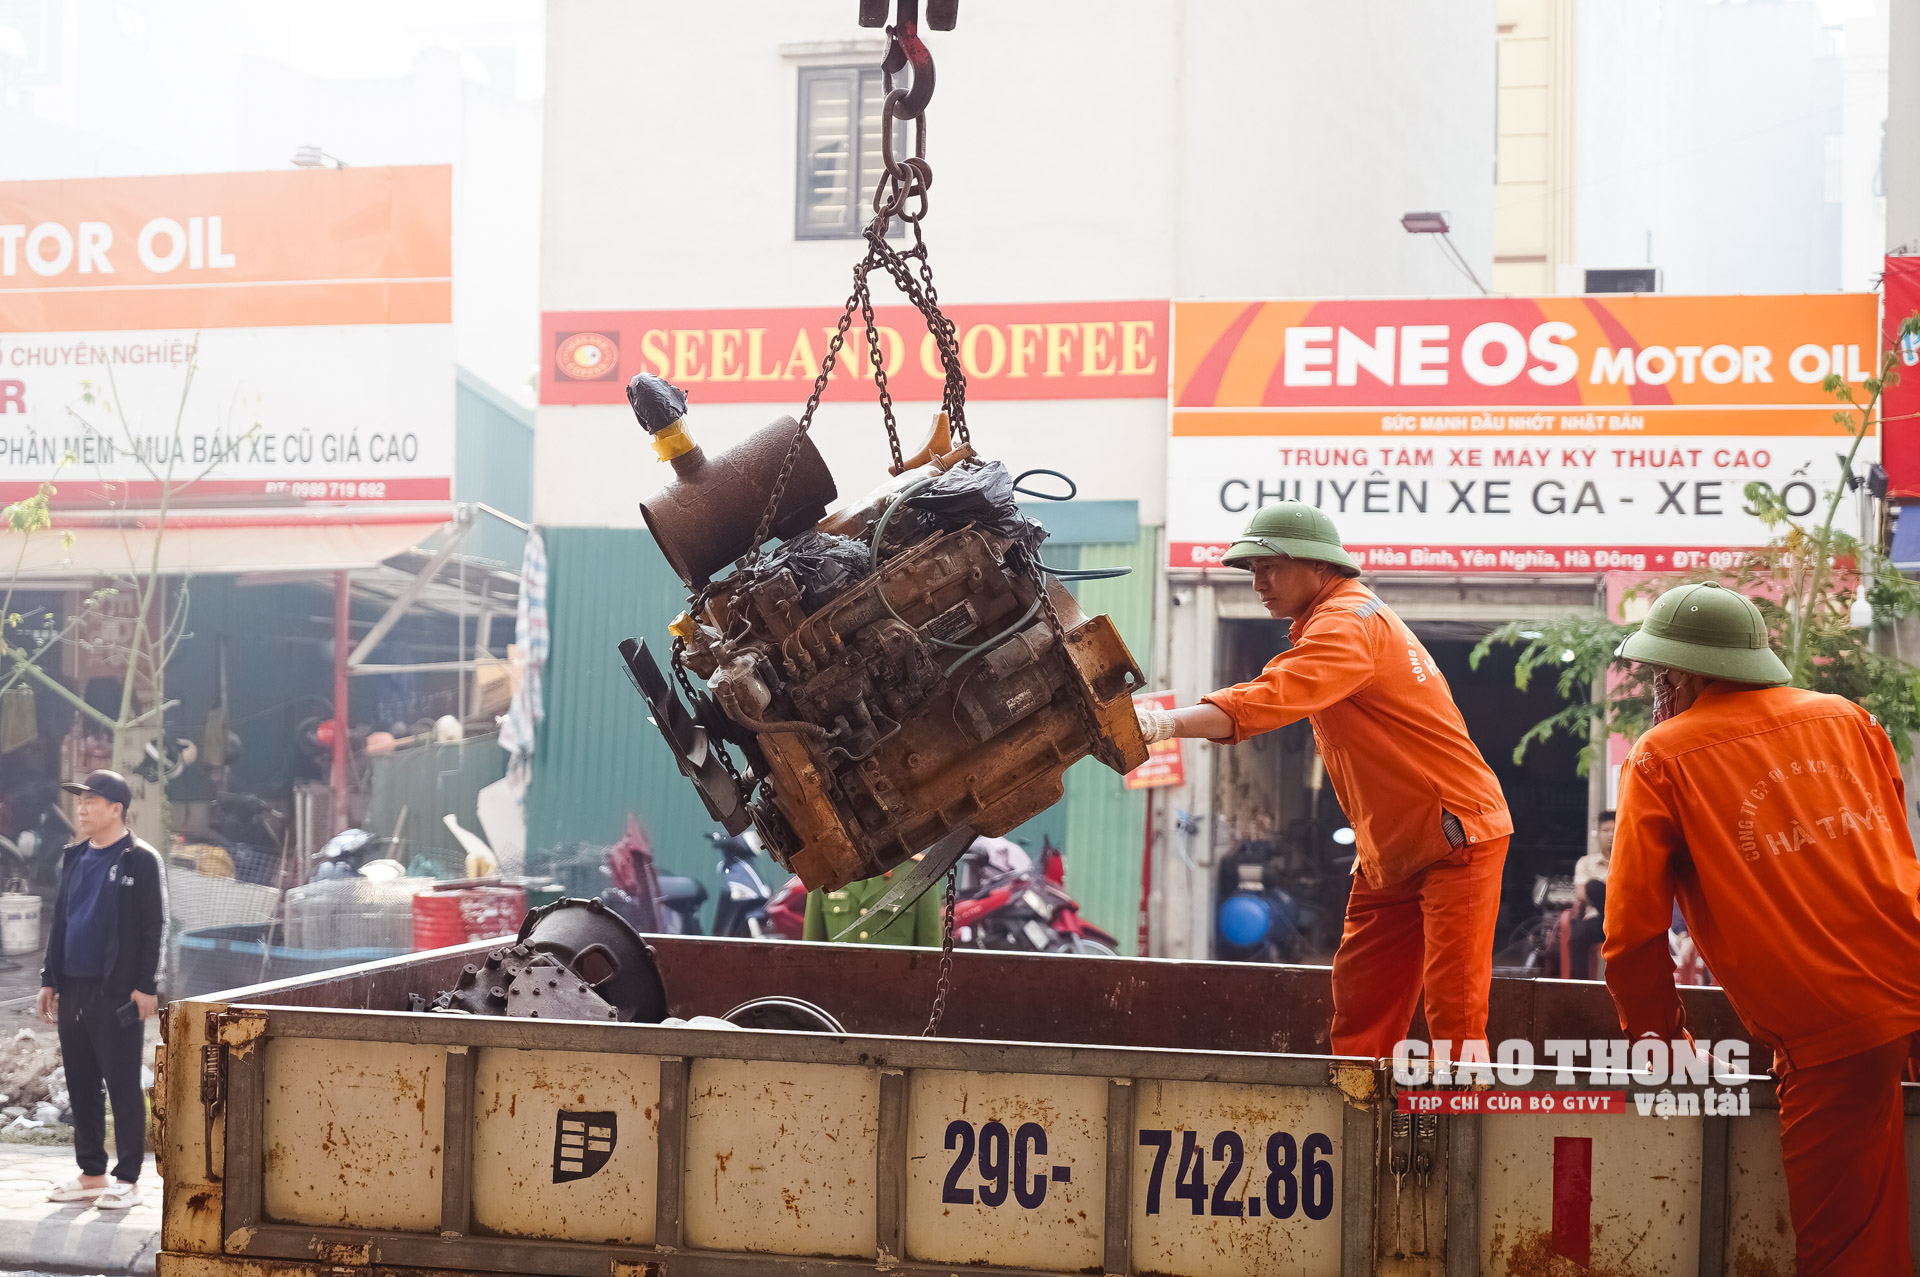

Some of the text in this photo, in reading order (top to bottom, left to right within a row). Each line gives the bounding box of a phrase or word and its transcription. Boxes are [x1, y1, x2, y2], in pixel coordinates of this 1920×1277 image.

[137, 216, 236, 274] OIL
[11, 341, 105, 366] CHUYÊN
[640, 325, 906, 384] SEELAND
[919, 320, 1159, 380] COFFEE
[1284, 321, 1579, 387] ENEOS
[1589, 344, 1774, 386] MOTOR
[1789, 343, 1870, 384] OIL
[1382, 413, 1416, 431] SỨC
[1420, 416, 1468, 433] MẠNH
[1561, 414, 1606, 433] NHẬT
[136, 435, 184, 463] MUA
[193, 427, 240, 463] BÁN
[250, 434, 277, 463] XE
[322, 427, 362, 463] GIÁ
[370, 433, 418, 463] CAO
[1280, 448, 1368, 467] TRUNG
[1448, 449, 1482, 467] XE
[1713, 449, 1771, 468] CAO
[1219, 470, 1427, 514] CHUYÊN
[1448, 480, 1511, 514] XE
[1532, 480, 1605, 515] GA
[1657, 481, 1723, 515] XE
[1460, 549, 1496, 567] Yên
[1564, 549, 1590, 568] Hà
[1594, 549, 1646, 571] Đông
[1740, 798, 1759, 817] TY
[1765, 819, 1816, 856] HÀ
[1815, 805, 1874, 840] TÂY
[941, 1119, 1334, 1220] 29C- 742.86
